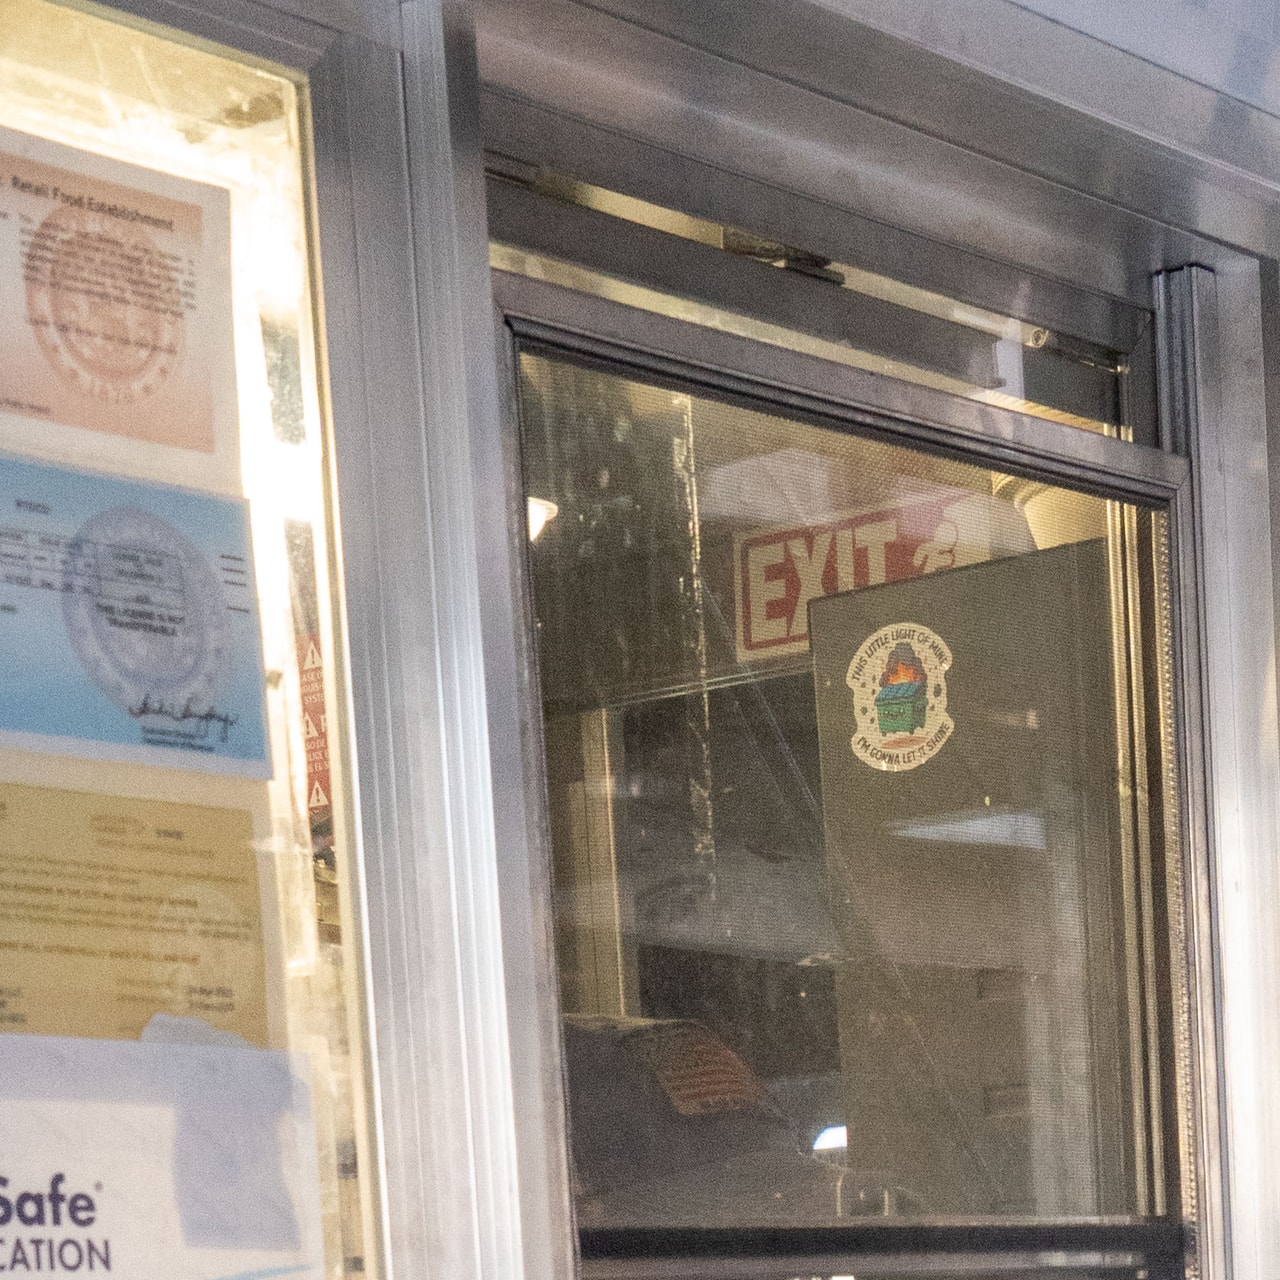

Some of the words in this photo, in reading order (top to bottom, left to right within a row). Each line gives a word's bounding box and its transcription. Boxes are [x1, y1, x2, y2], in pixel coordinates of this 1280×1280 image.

[750, 518, 898, 643] EXIT
[852, 656, 868, 681] THIS
[866, 633, 890, 658] LITTLE
[891, 628, 917, 641] LIGHT
[917, 633, 929, 645] OF
[870, 748, 900, 765] GONNA
[902, 753, 917, 764] LET
